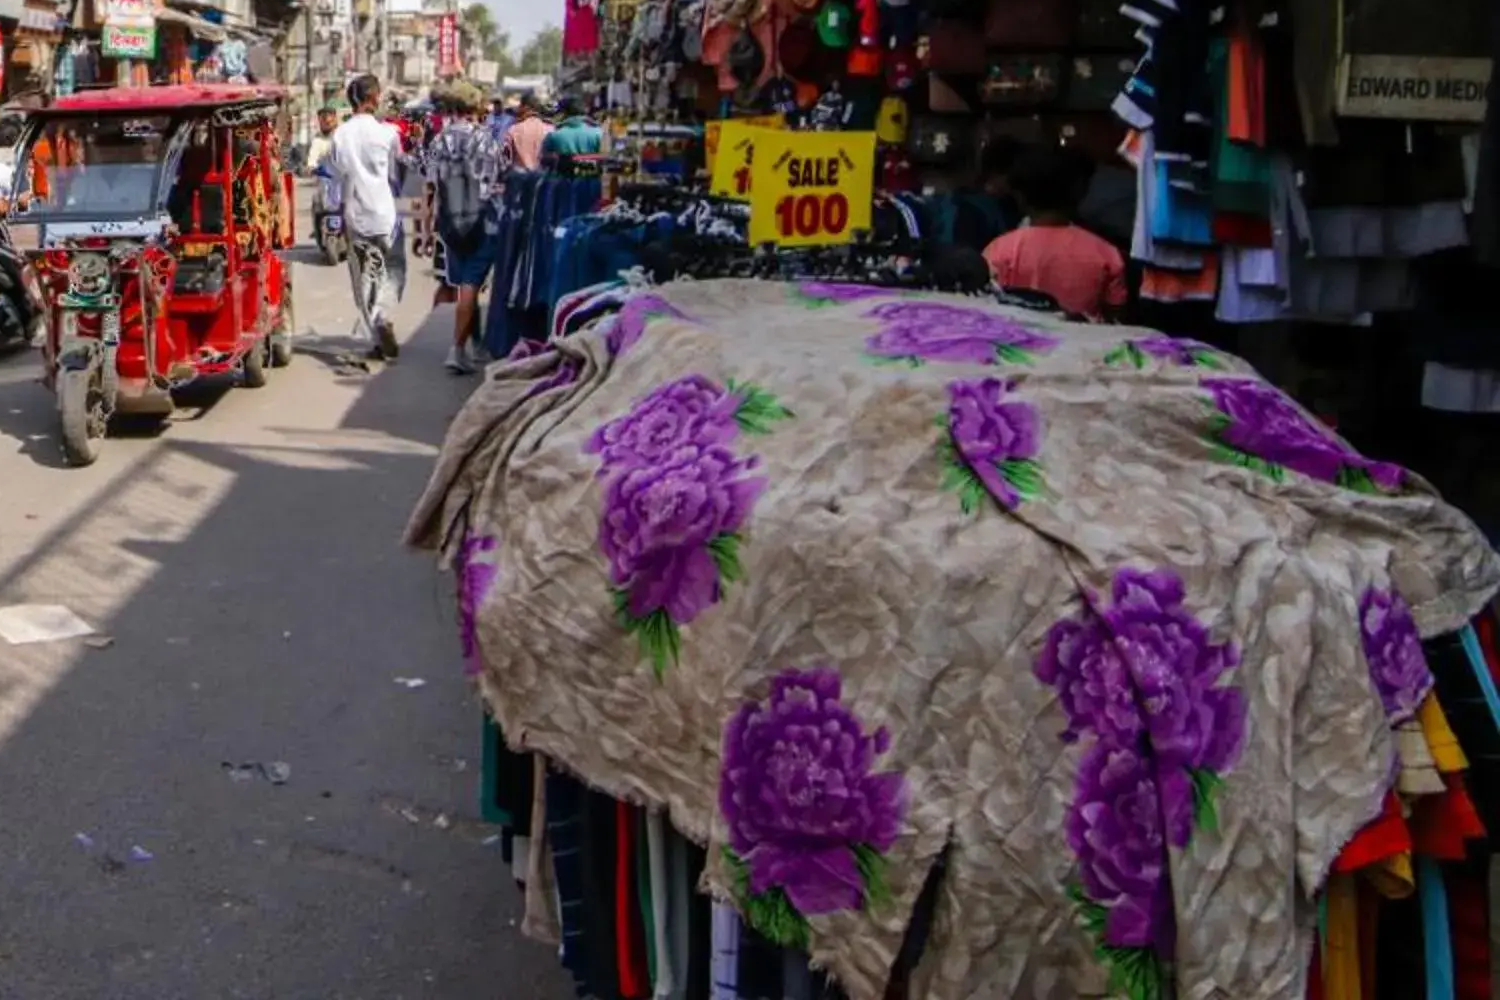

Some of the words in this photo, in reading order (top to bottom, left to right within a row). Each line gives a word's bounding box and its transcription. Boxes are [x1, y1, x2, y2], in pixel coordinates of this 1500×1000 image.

[1347, 77, 1430, 99] EDWARD
[788, 158, 839, 187] SALE
[775, 192, 849, 237] 100
